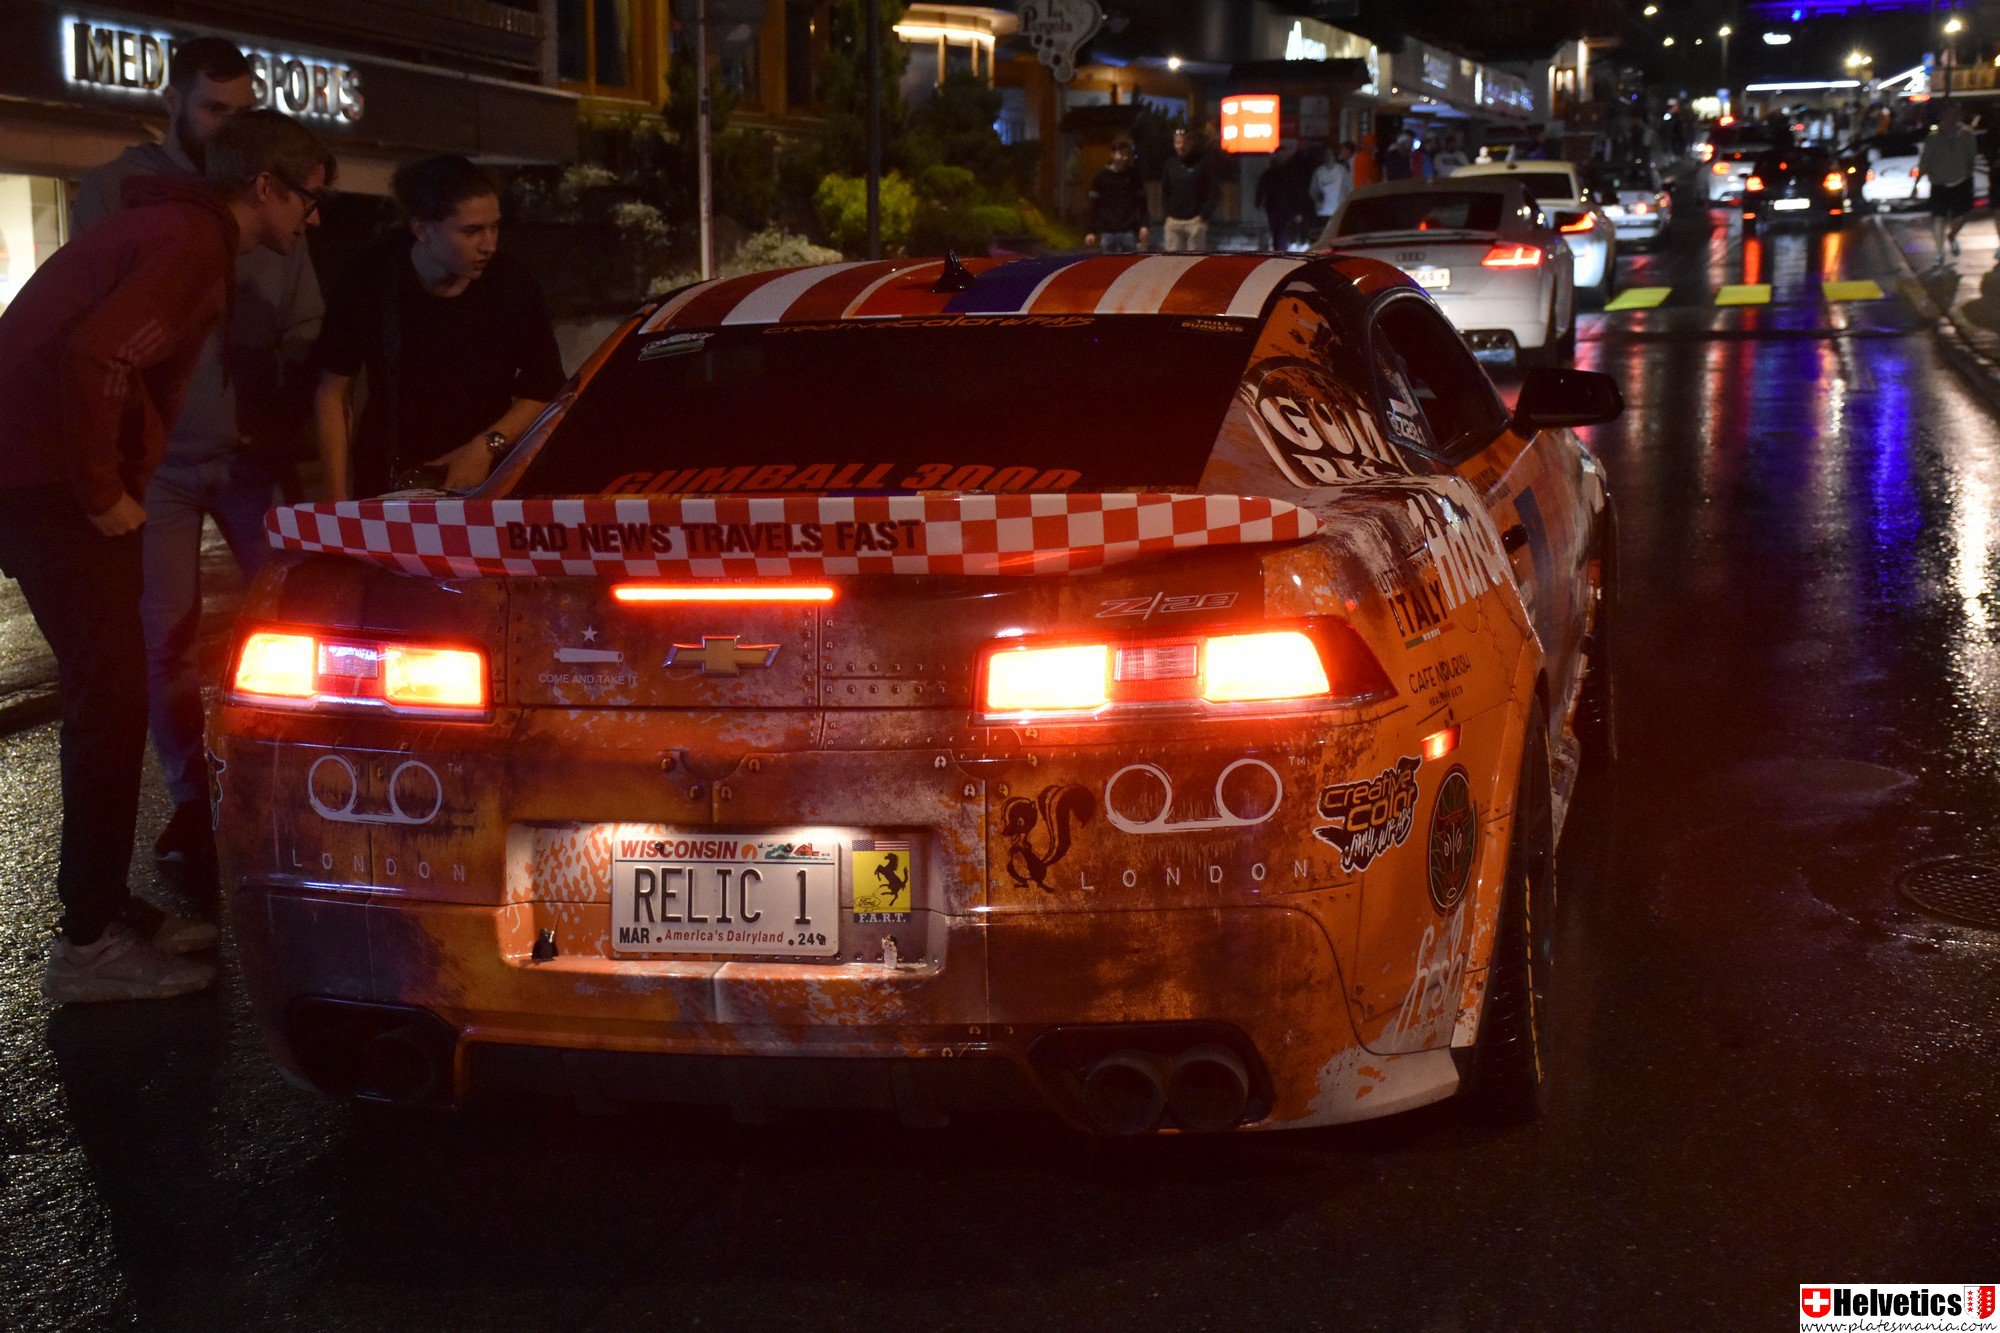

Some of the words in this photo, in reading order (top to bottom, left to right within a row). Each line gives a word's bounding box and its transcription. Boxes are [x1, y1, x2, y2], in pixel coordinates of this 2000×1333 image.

[603, 463, 895, 494] GUMBALL
[902, 462, 1083, 491] 3000
[506, 521, 568, 551] BAD
[577, 522, 673, 554] NEWS
[681, 521, 824, 554] TRAVELS
[836, 519, 921, 552] FAST
[1387, 579, 1448, 638] ITALY
[538, 674, 570, 684] COME
[572, 674, 595, 684] AND
[597, 675, 625, 685] TAKE
[1409, 666, 1438, 694] CAFE
[1289, 756, 1306, 766] TM
[620, 840, 738, 860] WISCONSIN
[292, 849, 466, 882] LONDON
[1080, 859, 1308, 890] LONDON
[633, 867, 763, 924] RELIC
[795, 869, 812, 925] 1
[858, 913, 907, 923] F.A.R.T.
[619, 927, 650, 944] MAR
[664, 929, 725, 942] America's
[726, 930, 785, 945] Dairyland
